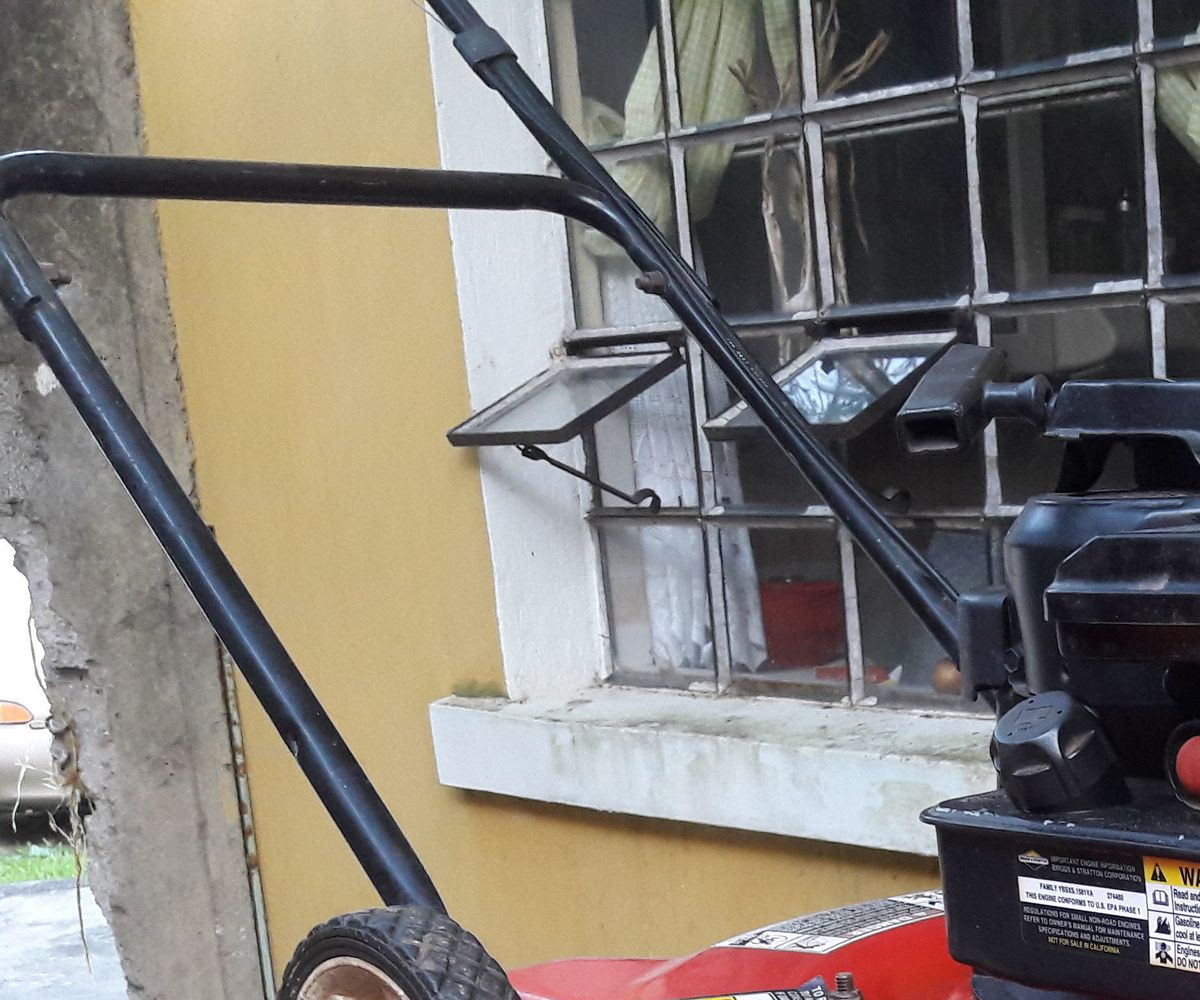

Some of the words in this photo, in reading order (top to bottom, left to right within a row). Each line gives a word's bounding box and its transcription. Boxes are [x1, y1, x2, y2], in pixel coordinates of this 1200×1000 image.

[1040, 882, 1057, 892] FAMILY
[1174, 889, 1188, 900] Read
[1190, 891, 1200, 901] and
[1025, 891, 1037, 900] THIS
[1038, 893, 1057, 902] ENGINE
[1058, 896, 1086, 906] CONFORMS
[1107, 903, 1117, 911] EPA
[1118, 905, 1136, 914] PHASE
[1060, 911, 1070, 919] FOR
[1175, 916, 1200, 929] Gasoline
[1095, 926, 1106, 934] FOR
[1176, 930, 1188, 939] cool
[1189, 932, 1195, 941] at
[1080, 933, 1091, 941] AND
[1048, 936, 1058, 944] NOT
[1059, 938, 1069, 946] FOR
[1070, 940, 1083, 949] SALE
[1090, 943, 1120, 954] CALIFORNIA
[1177, 944, 1200, 958] Engines
[1177, 957, 1187, 967] DO
